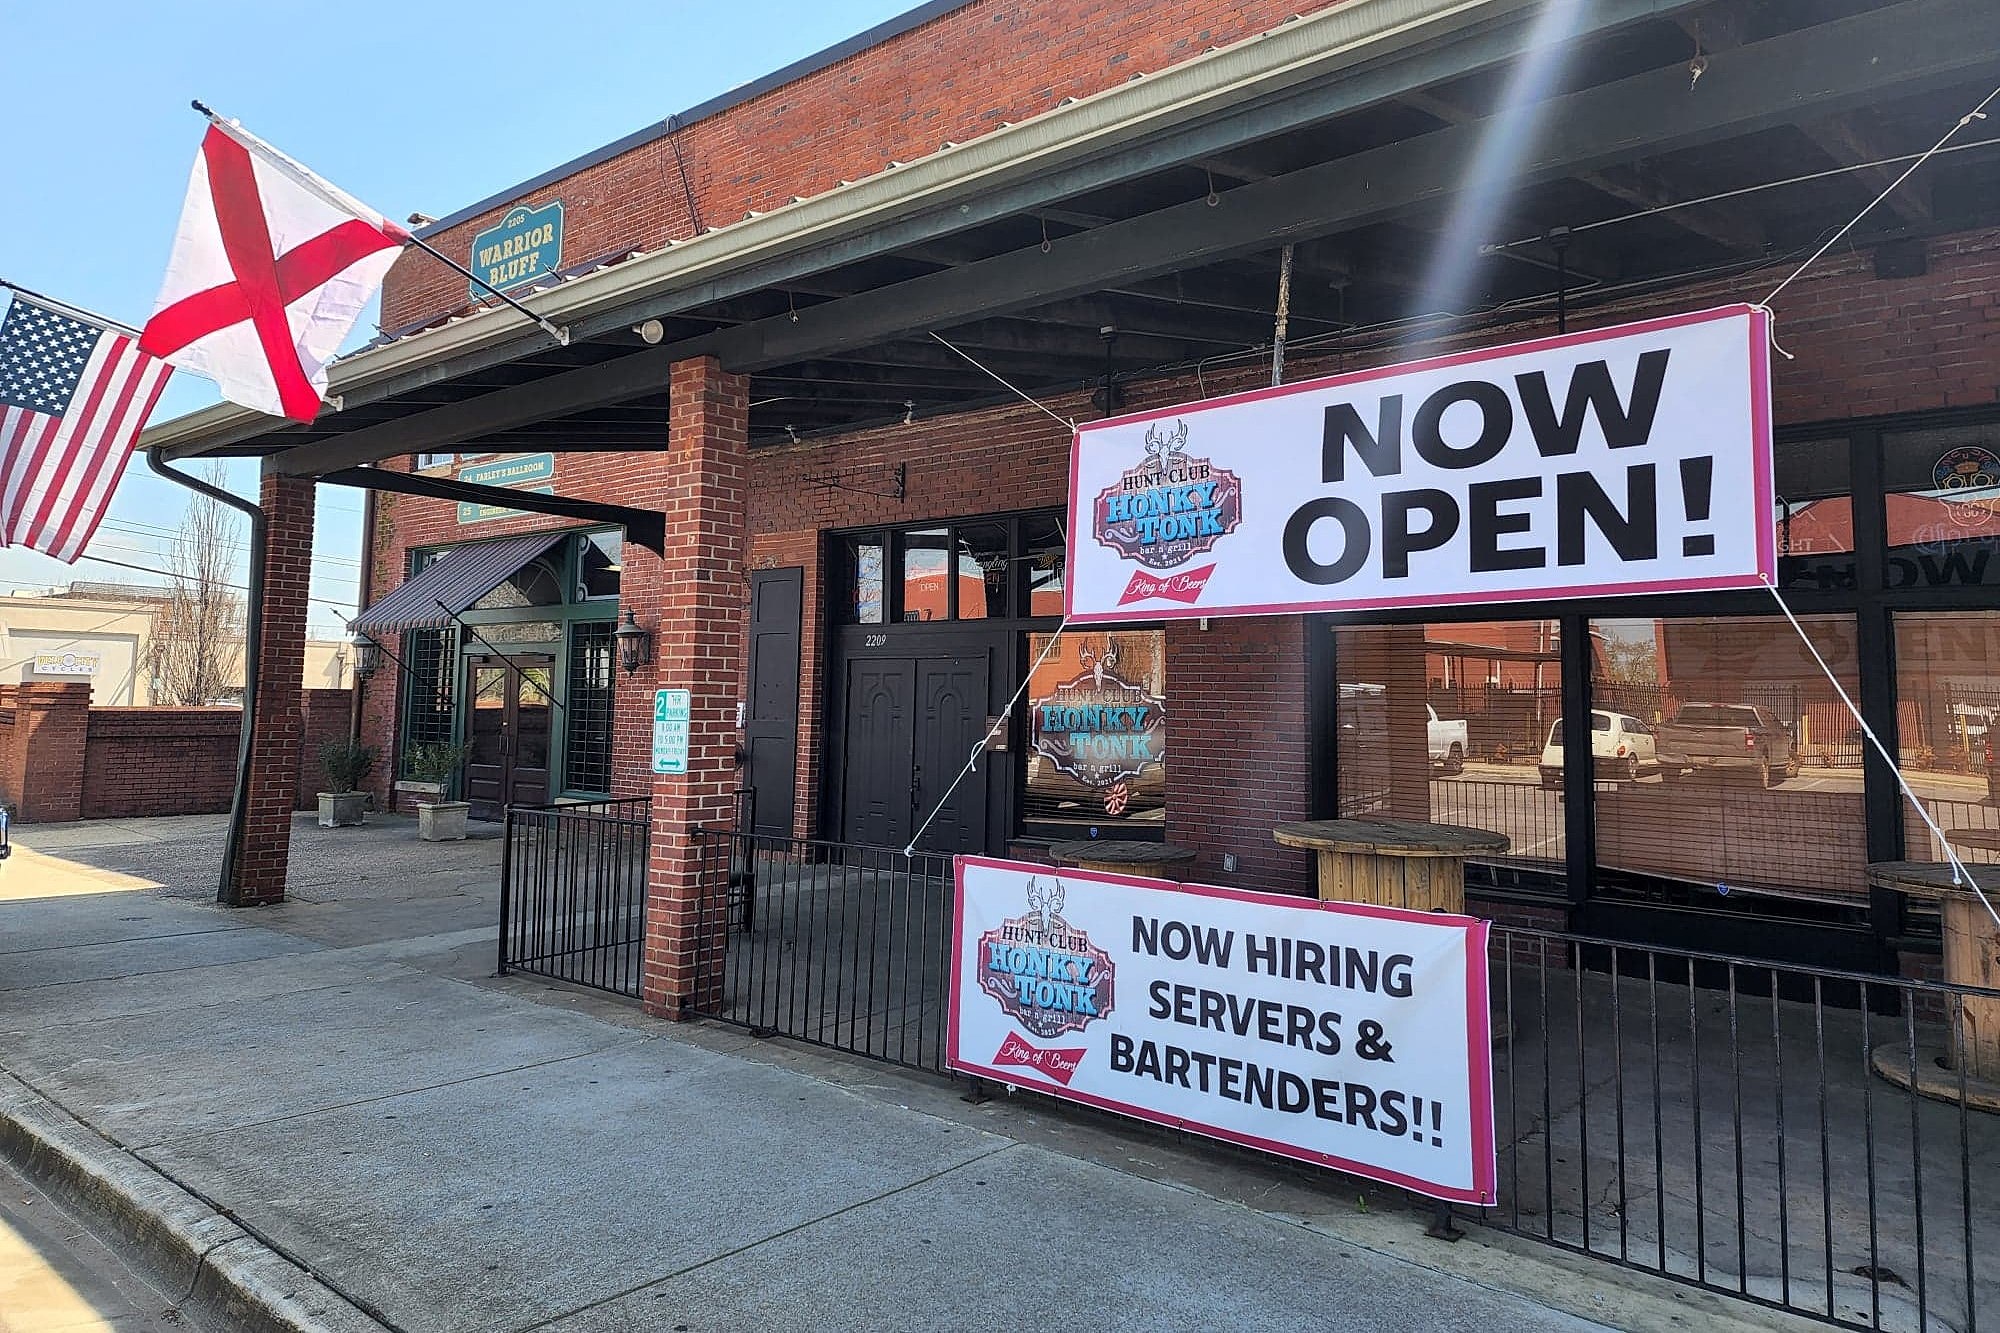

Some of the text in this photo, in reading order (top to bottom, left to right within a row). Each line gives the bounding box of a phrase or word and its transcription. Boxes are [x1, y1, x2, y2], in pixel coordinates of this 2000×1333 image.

[508, 214, 525, 228] 2205
[480, 223, 553, 267] WARRIOR
[490, 251, 539, 286] BLUFF
[1322, 348, 1671, 483] NOW
[507, 462, 544, 476] BALLROOM
[1123, 465, 1210, 490] HUNT CLUB
[1106, 481, 1217, 523] HONKY
[1136, 508, 1225, 546] TONK
[1282, 455, 1715, 585] OPEN!
[1139, 546, 1154, 555] bar
[1167, 542, 1191, 555] grill
[920, 582, 939, 592] OPEN
[1126, 576, 1207, 597] King of Beers
[865, 634, 887, 647] 2209
[656, 694, 681, 717] 2 HR
[1104, 689, 1143, 703] CLUB
[667, 707, 687, 718] PARKING
[1041, 705, 1149, 732] HONKY
[674, 723, 681, 731] AM
[676, 736, 683, 745] PM
[1070, 732, 1153, 760] TONK
[1073, 762, 1086, 771] bar
[1099, 763, 1121, 774] grill
[1002, 926, 1088, 952] HUNT CLUB
[989, 942, 1094, 986] HONKY
[1132, 915, 1413, 998] NOW HIRING
[1015, 975, 1099, 1017] TONK
[1019, 1007, 1032, 1018] bar
[1042, 1012, 1065, 1025] grill
[1149, 980, 1395, 1063] SERVERS &
[1000, 1041, 1077, 1072] King of Beers
[1110, 1033, 1443, 1148] BARTENDERS!!
